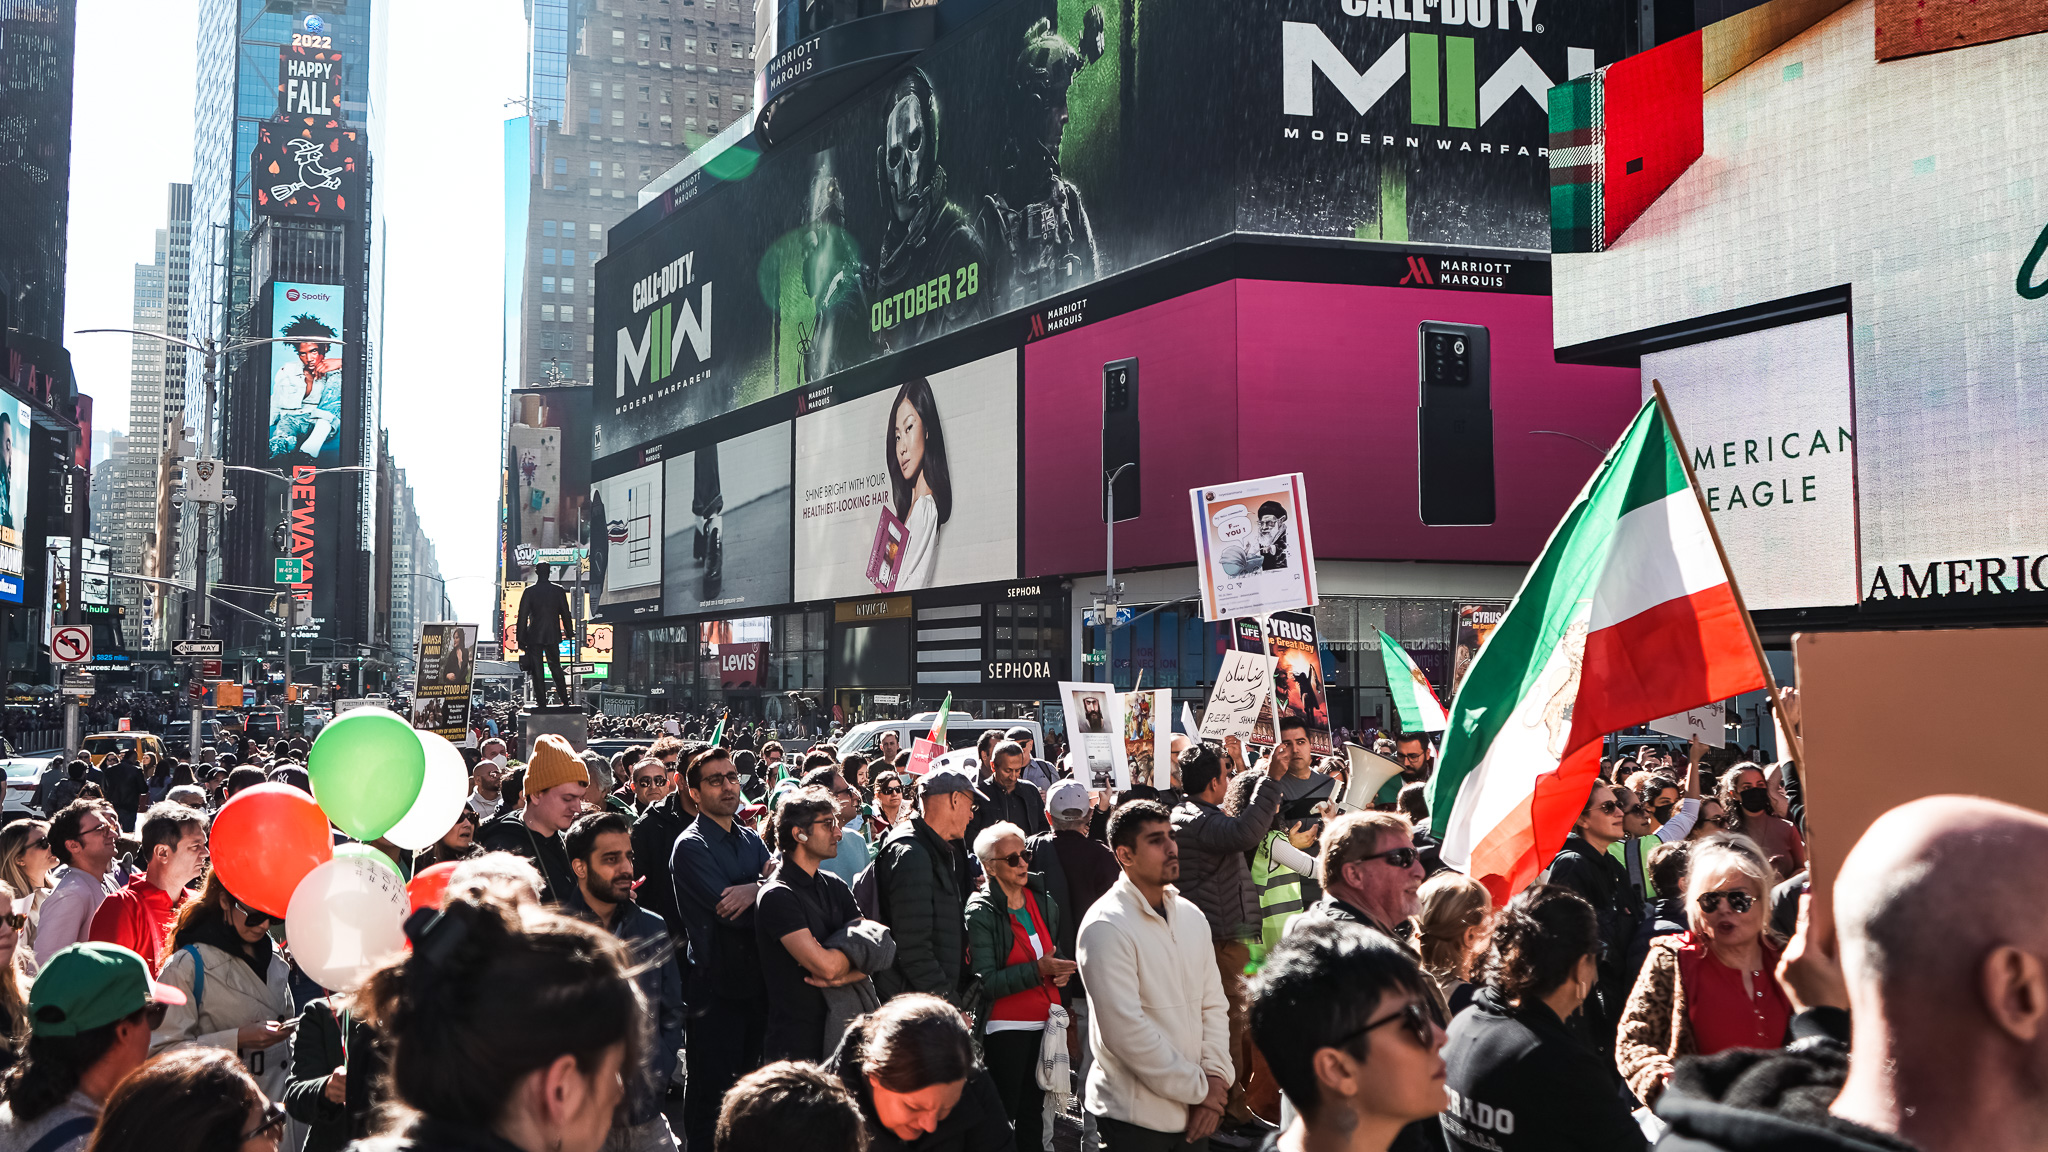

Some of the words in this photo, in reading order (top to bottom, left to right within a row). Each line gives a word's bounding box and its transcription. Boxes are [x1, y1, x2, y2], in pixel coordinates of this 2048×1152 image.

[292, 33, 332, 49] 2022
[770, 37, 821, 75] MARRIOTT
[288, 60, 333, 79] HAPPY
[770, 58, 814, 91] MARQUIS
[287, 79, 332, 115] FALL
[1284, 128, 1419, 148] MODERN
[1437, 139, 1549, 158] WARFAR
[674, 171, 701, 196] MARRIOTT
[674, 186, 698, 207] MARQUIS
[1441, 260, 1512, 275] MARRIOTT
[1441, 273, 1504, 287] MARQUIS
[302, 292, 330, 302] Spotify
[632, 271, 659, 314] CALL
[871, 276, 951, 333] OCTOBER
[956, 262, 979, 297] 28
[1047, 299, 1088, 319] MARRIOTT
[1047, 313, 1083, 332] MARQUIS
[808, 385, 834, 401] MARRIOTT
[615, 393, 654, 416] MODERN
[808, 396, 831, 410] MARQUIS
[1693, 426, 1853, 472] MERICAN
[64, 474, 73, 514] 1500
[805, 486, 823, 502] SHINE
[824, 481, 848, 498] BRIGHT
[849, 477, 866, 492] WITH
[866, 472, 887, 488] YOUR
[1706, 474, 1818, 512] EAGLE
[802, 495, 871, 520] HEALTHIEST-LOOKING
[871, 490, 890, 507] HAIR
[1225, 528, 1242, 538] YOU
[539, 548, 574, 556] THURSDAY
[1007, 585, 1041, 598] SEPHORA
[89, 605, 109, 613] hulu
[856, 601, 889, 616] INVICTA
[1472, 611, 1501, 624] CYRUS
[422, 635, 442, 645] MAHSA
[1240, 627, 1260, 638] LIFE
[179, 644, 194, 652] ONE
[200, 644, 216, 652] WAY
[424, 646, 441, 655] AMINI
[1276, 637, 1299, 649] Great
[1299, 641, 1315, 654] Day
[988, 661, 1051, 679] SEPHORA
[443, 684, 461, 695] STOOD
[460, 684, 470, 694] UP!
[1206, 712, 1231, 724] REZA
[1239, 715, 1256, 725] SHAH
